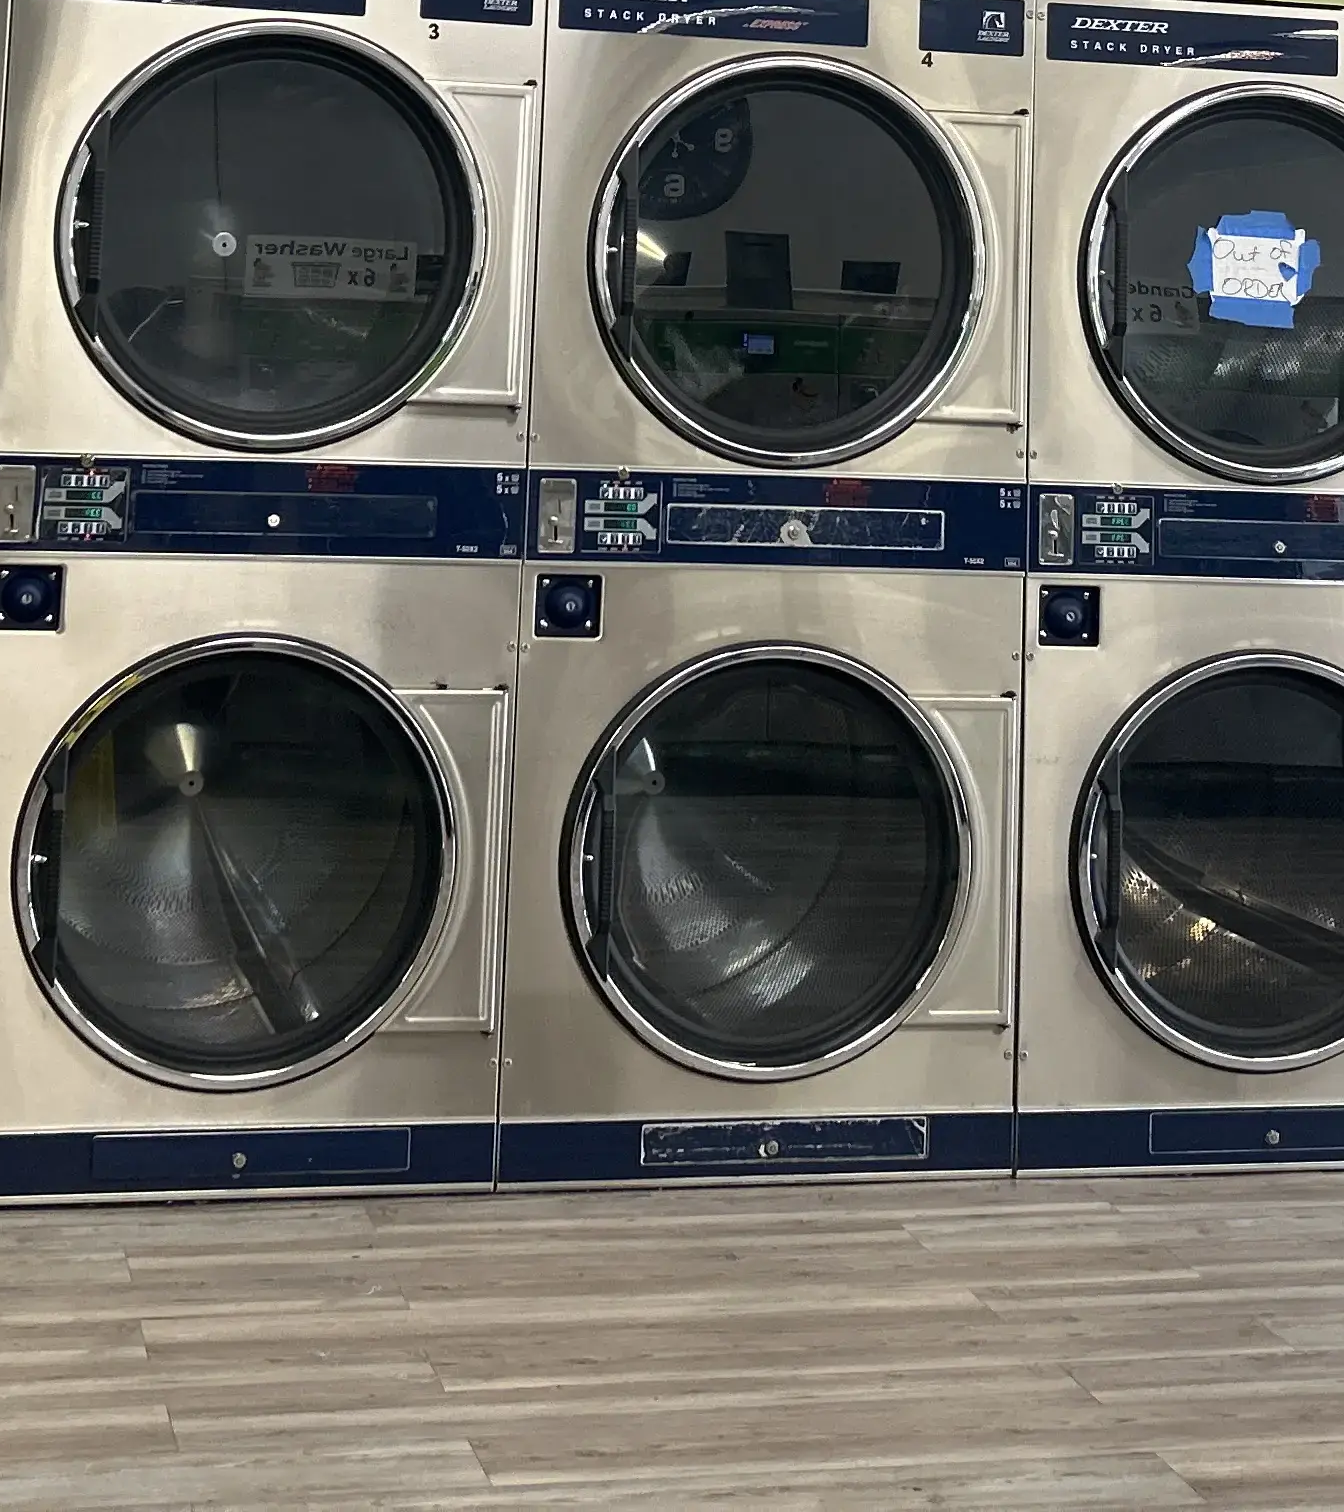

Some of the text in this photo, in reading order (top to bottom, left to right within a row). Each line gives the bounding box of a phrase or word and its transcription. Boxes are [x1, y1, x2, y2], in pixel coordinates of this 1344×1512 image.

[584, 8, 717, 27] STACK DRYER
[1070, 16, 1170, 35] DEXTER
[428, 23, 440, 40] 3
[1070, 40, 1196, 57] STACK DRYER
[920, 51, 934, 68] 4
[1212, 238, 1293, 263] Out of
[1221, 276, 1294, 304] ORDER
